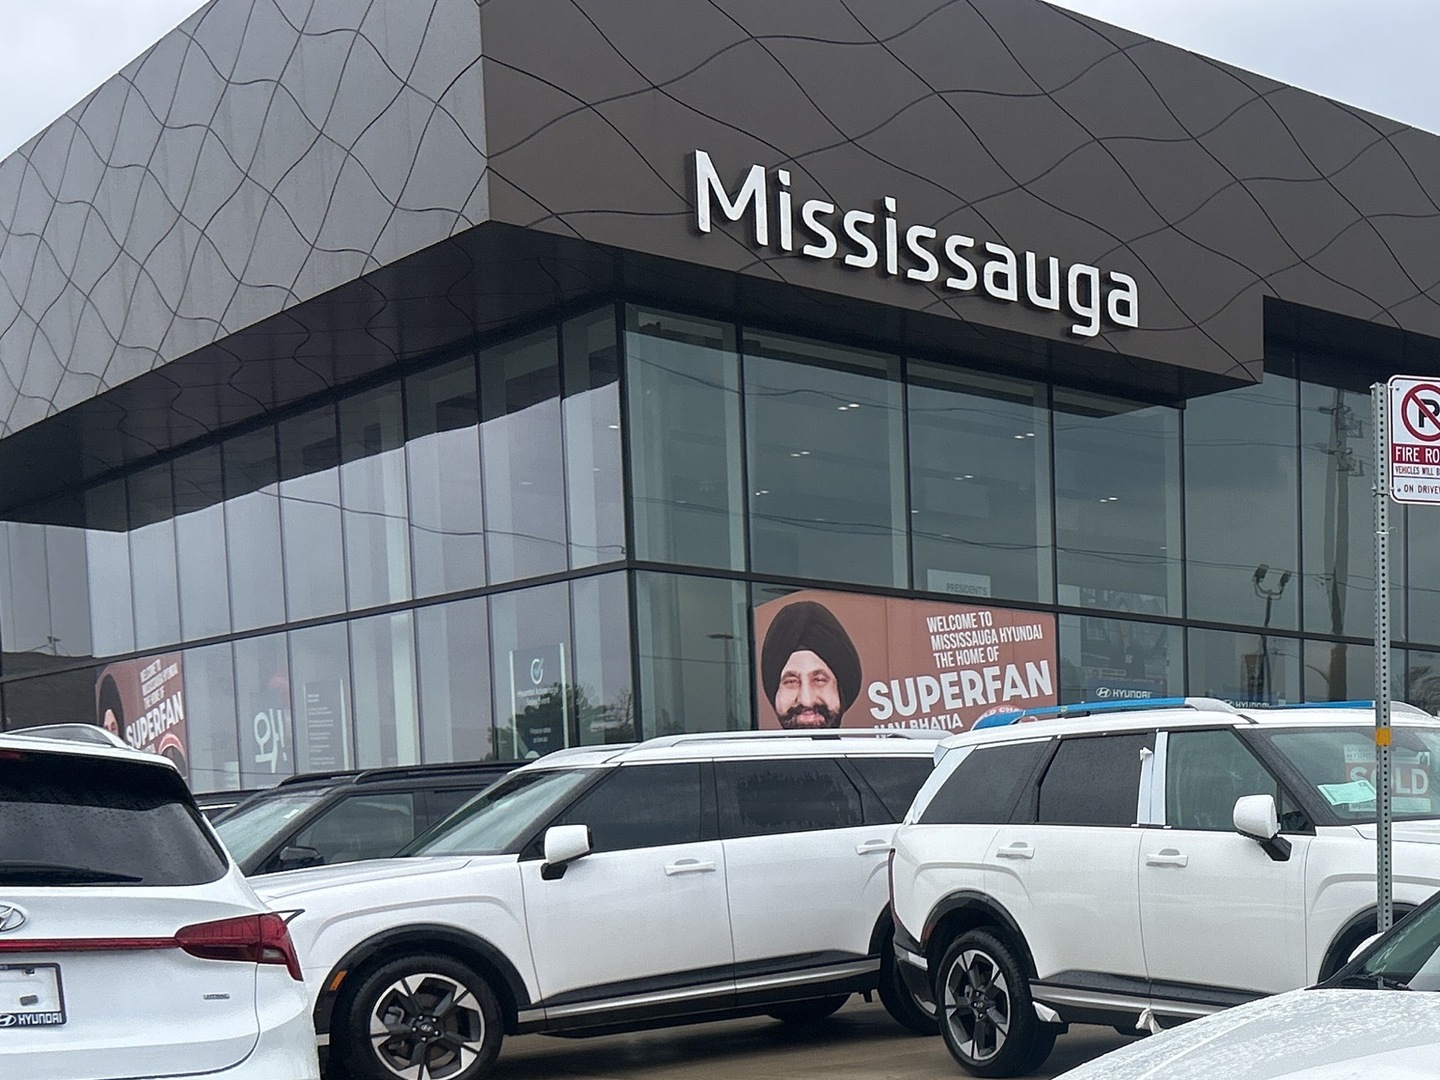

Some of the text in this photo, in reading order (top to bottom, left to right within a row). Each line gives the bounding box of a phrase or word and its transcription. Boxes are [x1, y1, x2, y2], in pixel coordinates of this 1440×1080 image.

[695, 148, 1139, 337] Mississauga
[1395, 446, 1420, 462] FIRE
[1395, 465, 1420, 475] VEHICLES
[1422, 466, 1435, 476] WILL
[1404, 484, 1413, 493] ON
[926, 611, 993, 633] WELCOME TO
[930, 624, 1043, 651] MISSISSAUGA HYUNDAI
[933, 646, 999, 668] THE HOME OF
[867, 660, 1053, 720] SUPERFAN
[126, 691, 185, 750] SUPERFAN
[18, 1012, 63, 1025] HYUNDAI
